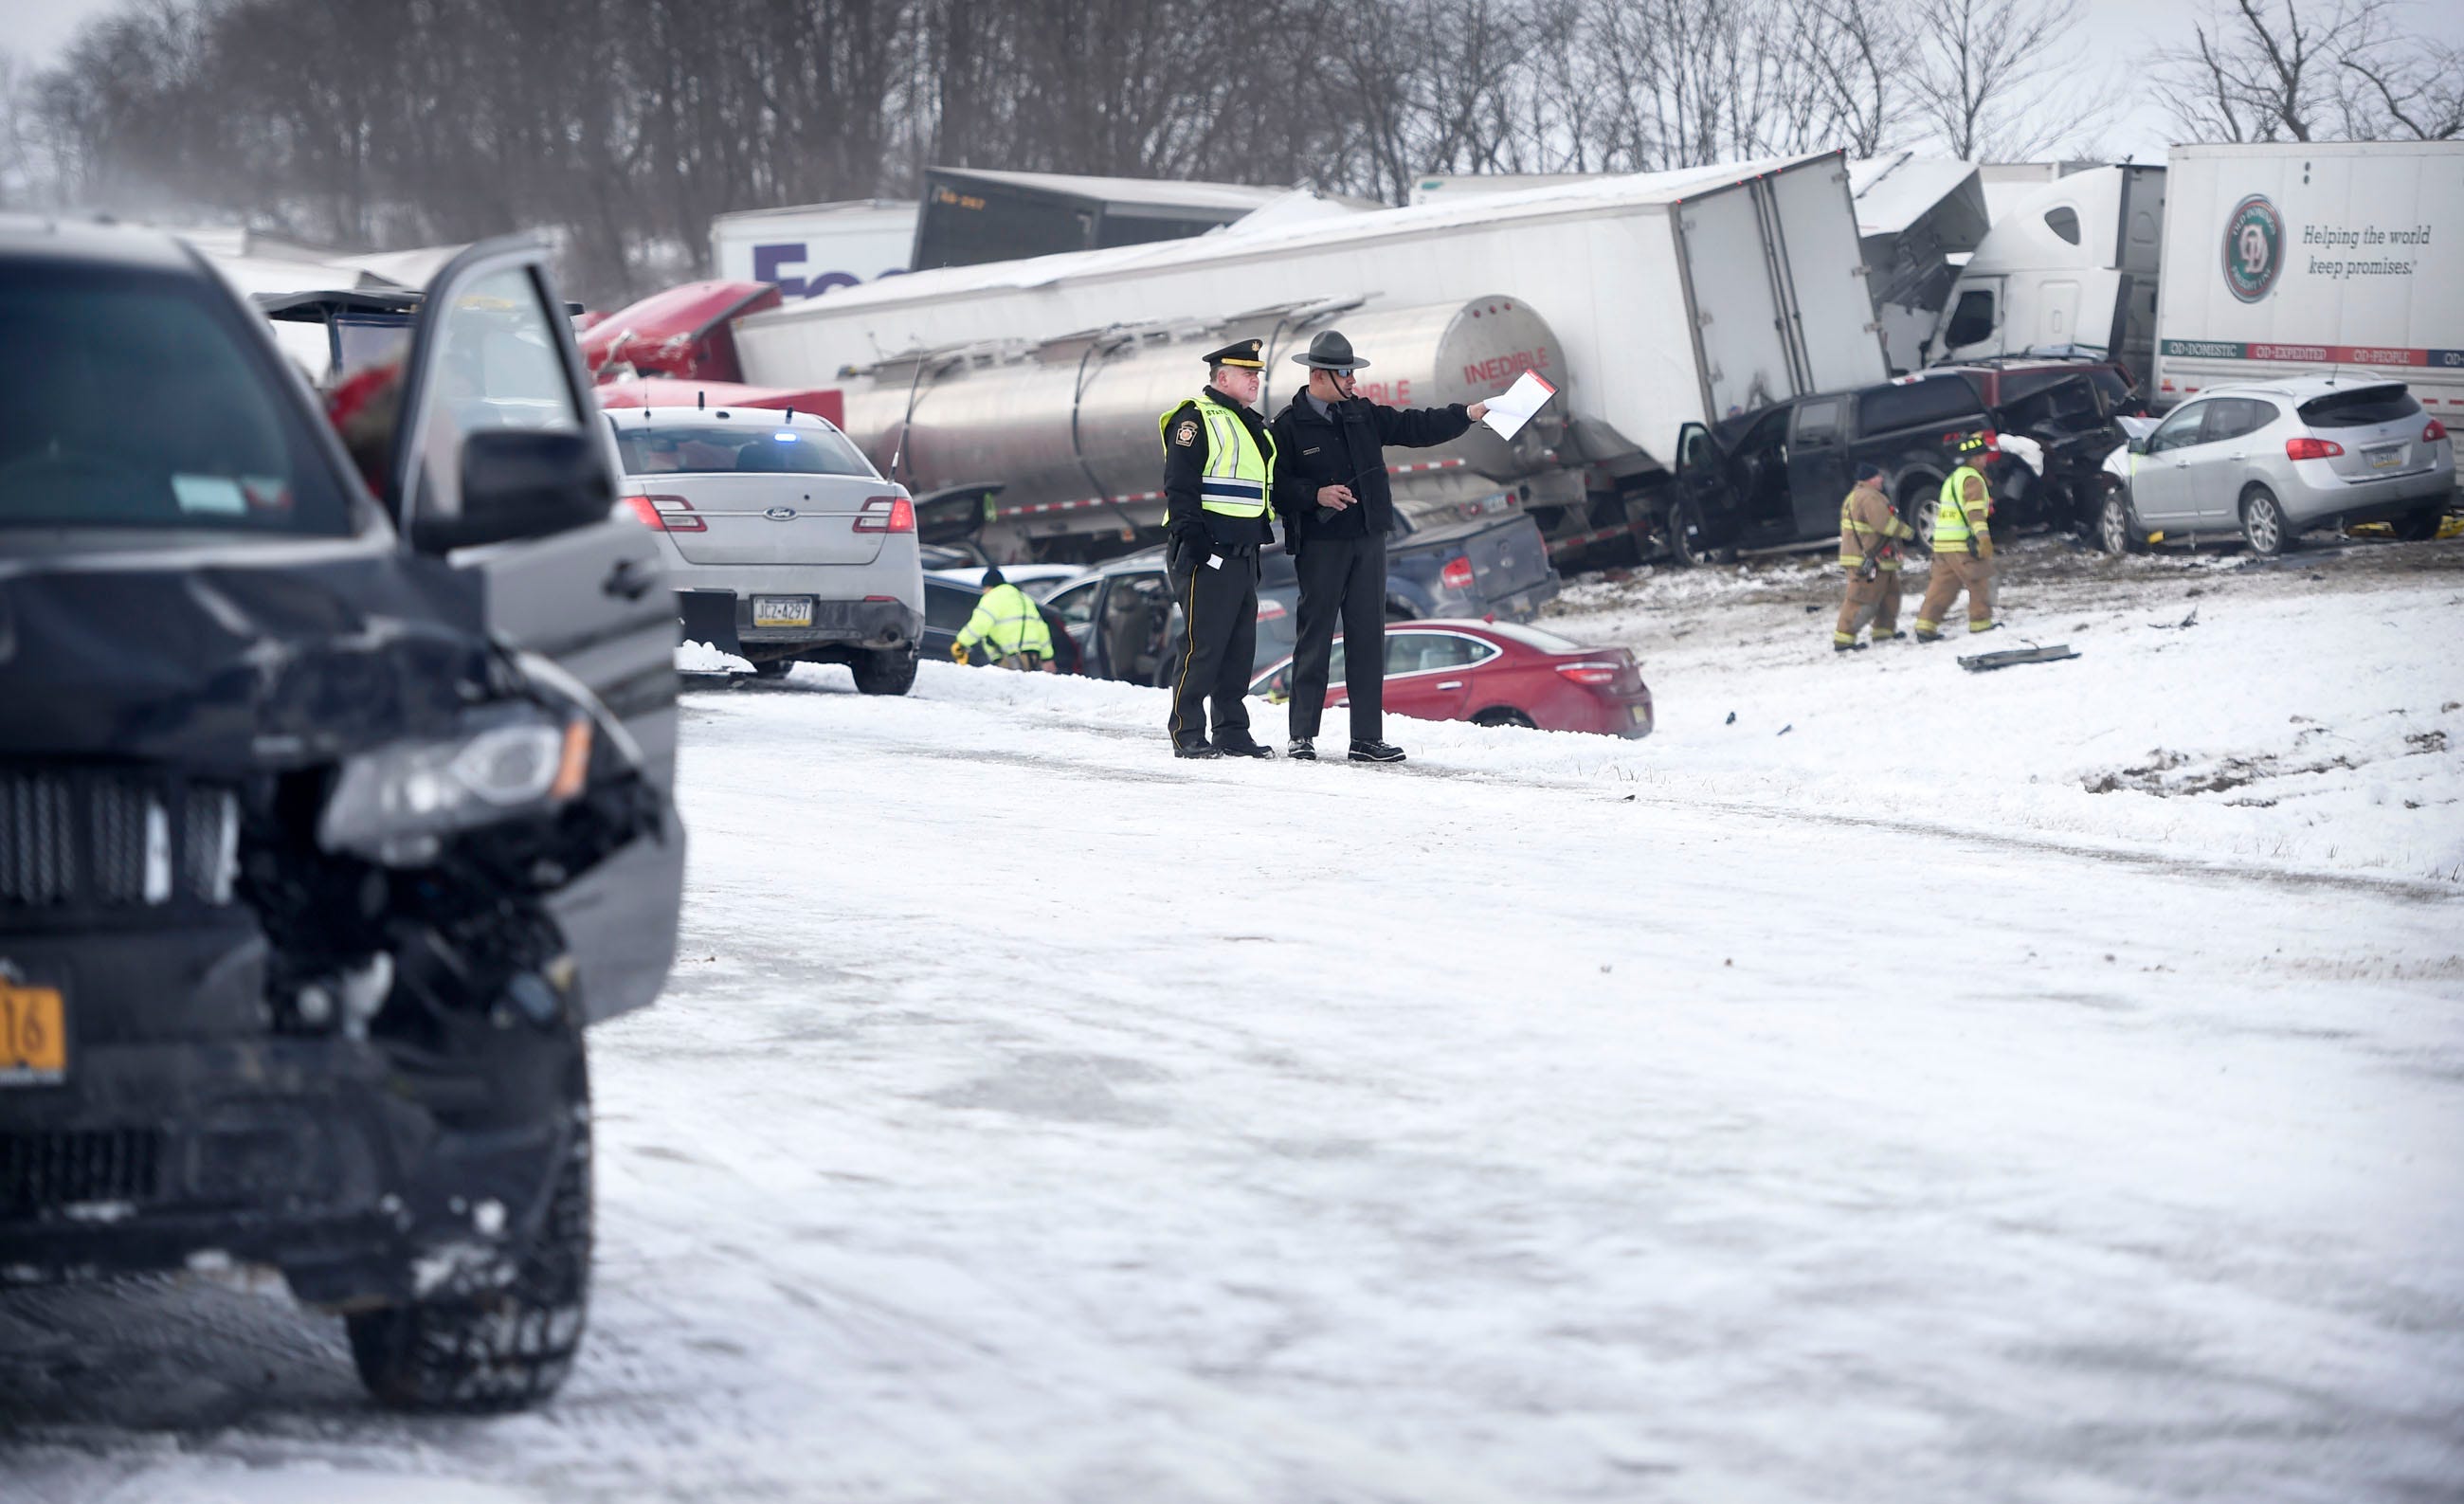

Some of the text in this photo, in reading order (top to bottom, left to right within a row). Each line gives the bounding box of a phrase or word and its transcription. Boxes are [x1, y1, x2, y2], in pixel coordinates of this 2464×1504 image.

[2303, 225, 2432, 249] Helping the world
[2309, 255, 2344, 279] keep
[1463, 347, 1549, 386] INEDIBLE
